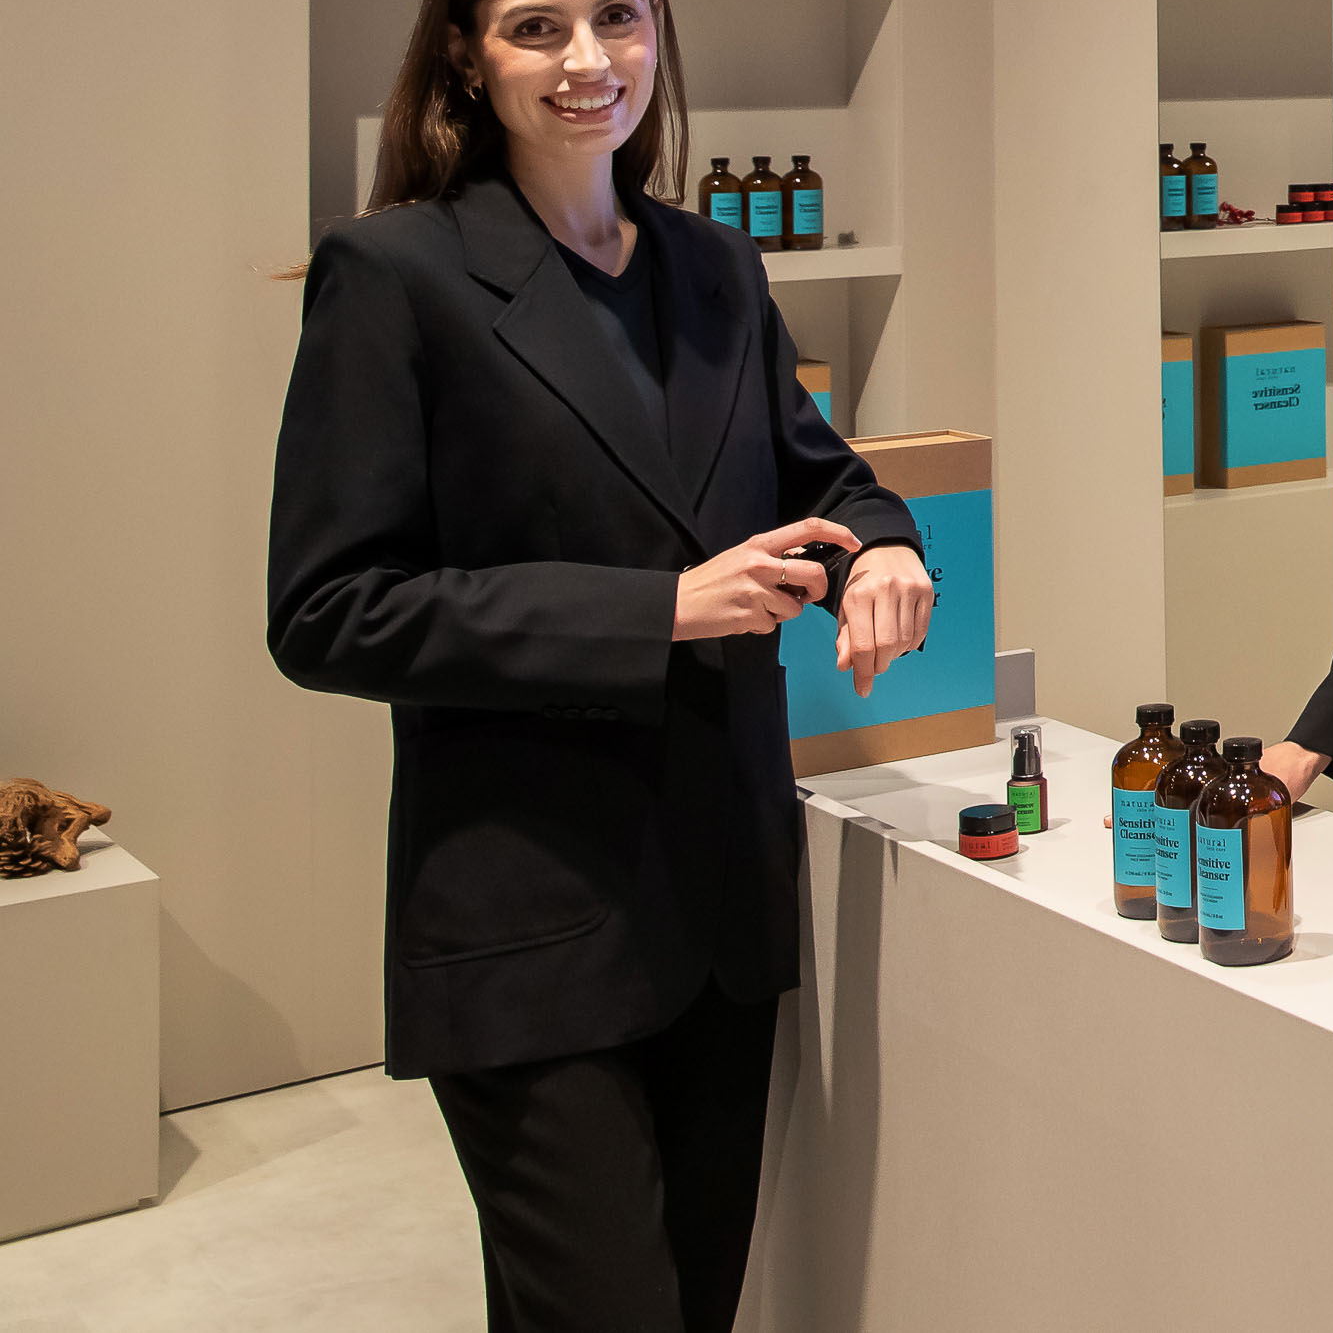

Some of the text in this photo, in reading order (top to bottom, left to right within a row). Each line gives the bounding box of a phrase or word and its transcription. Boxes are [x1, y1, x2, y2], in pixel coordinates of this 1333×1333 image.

[1120, 799, 1155, 808] natura
[1198, 856, 1231, 869] ensitive
[1198, 867, 1230, 881] leanser
